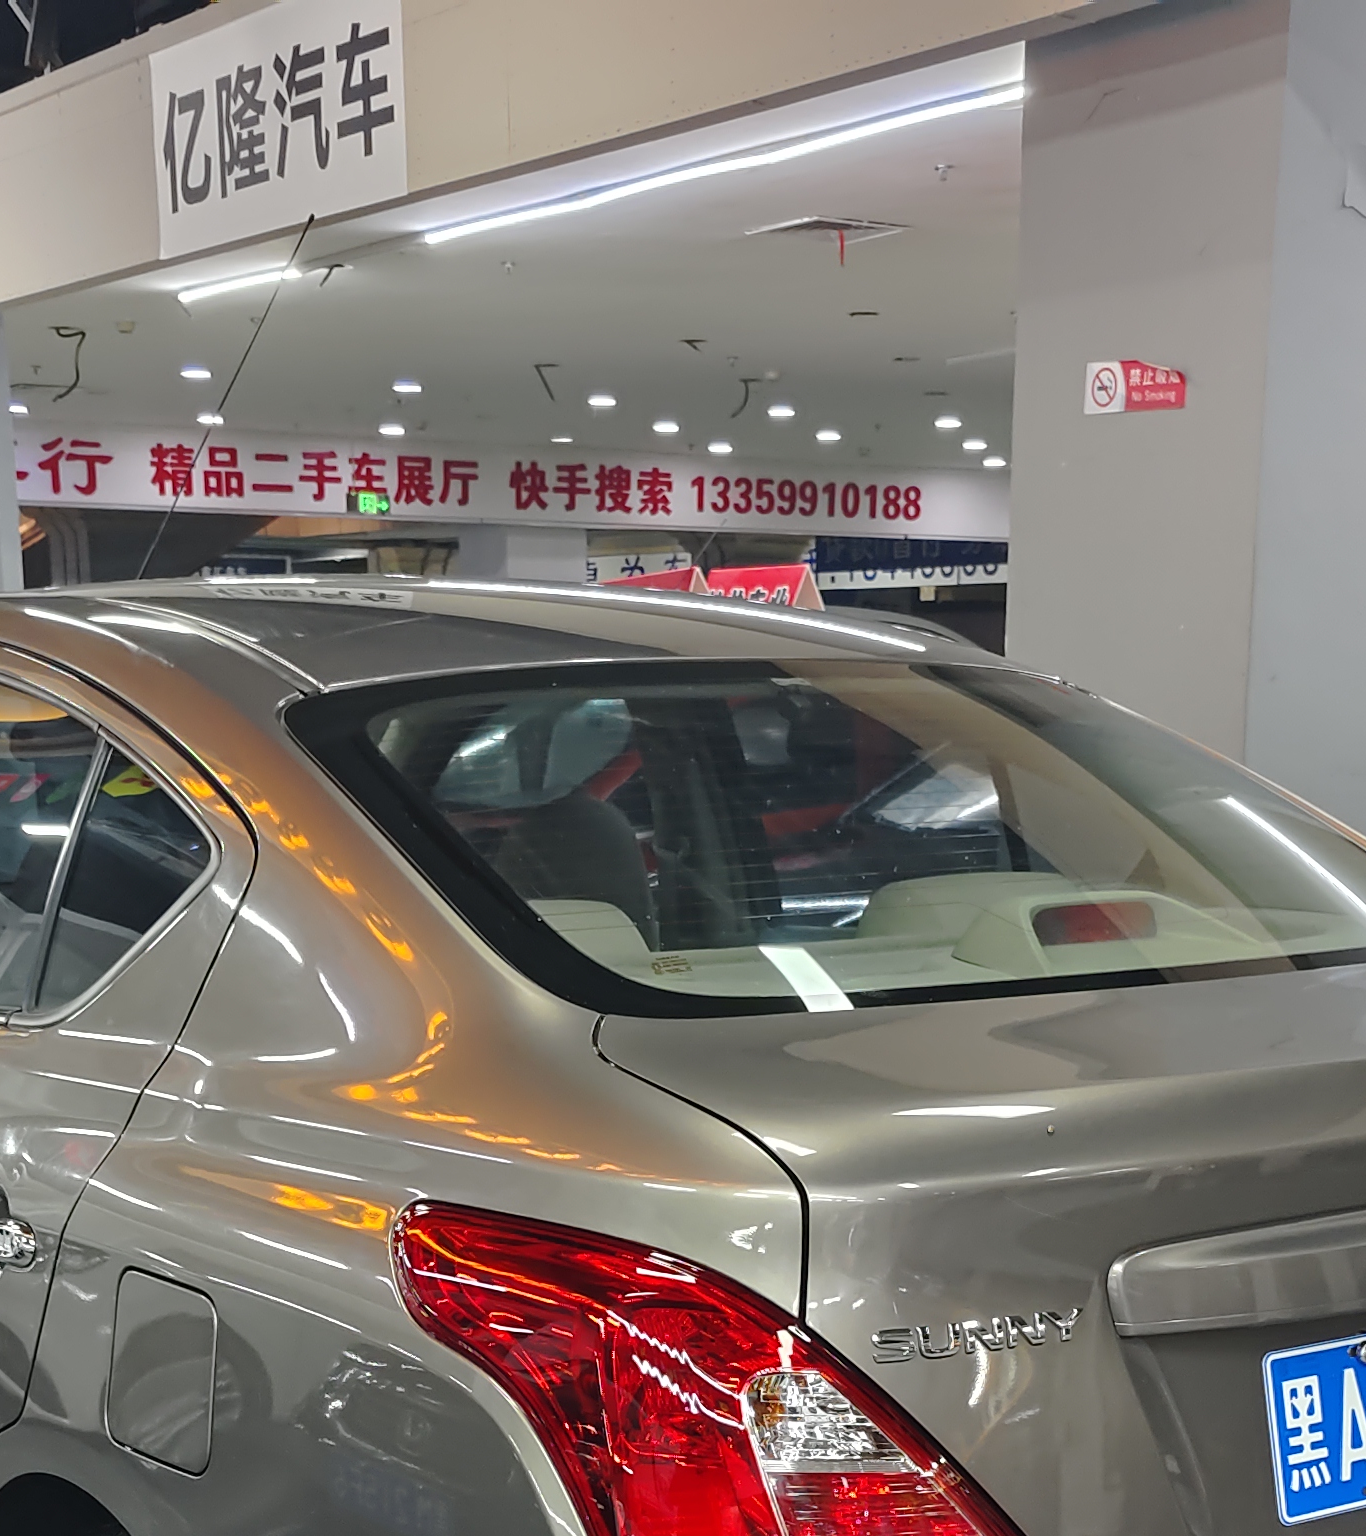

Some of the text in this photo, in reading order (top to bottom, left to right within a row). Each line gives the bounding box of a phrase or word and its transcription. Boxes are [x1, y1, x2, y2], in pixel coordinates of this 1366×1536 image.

[163, 22, 395, 214] 亿隆汽车
[15, 437, 923, 520] 行 精品二手车展厅 快手搜索 13359910188
[870, 1307, 1085, 1364] SUNNY
